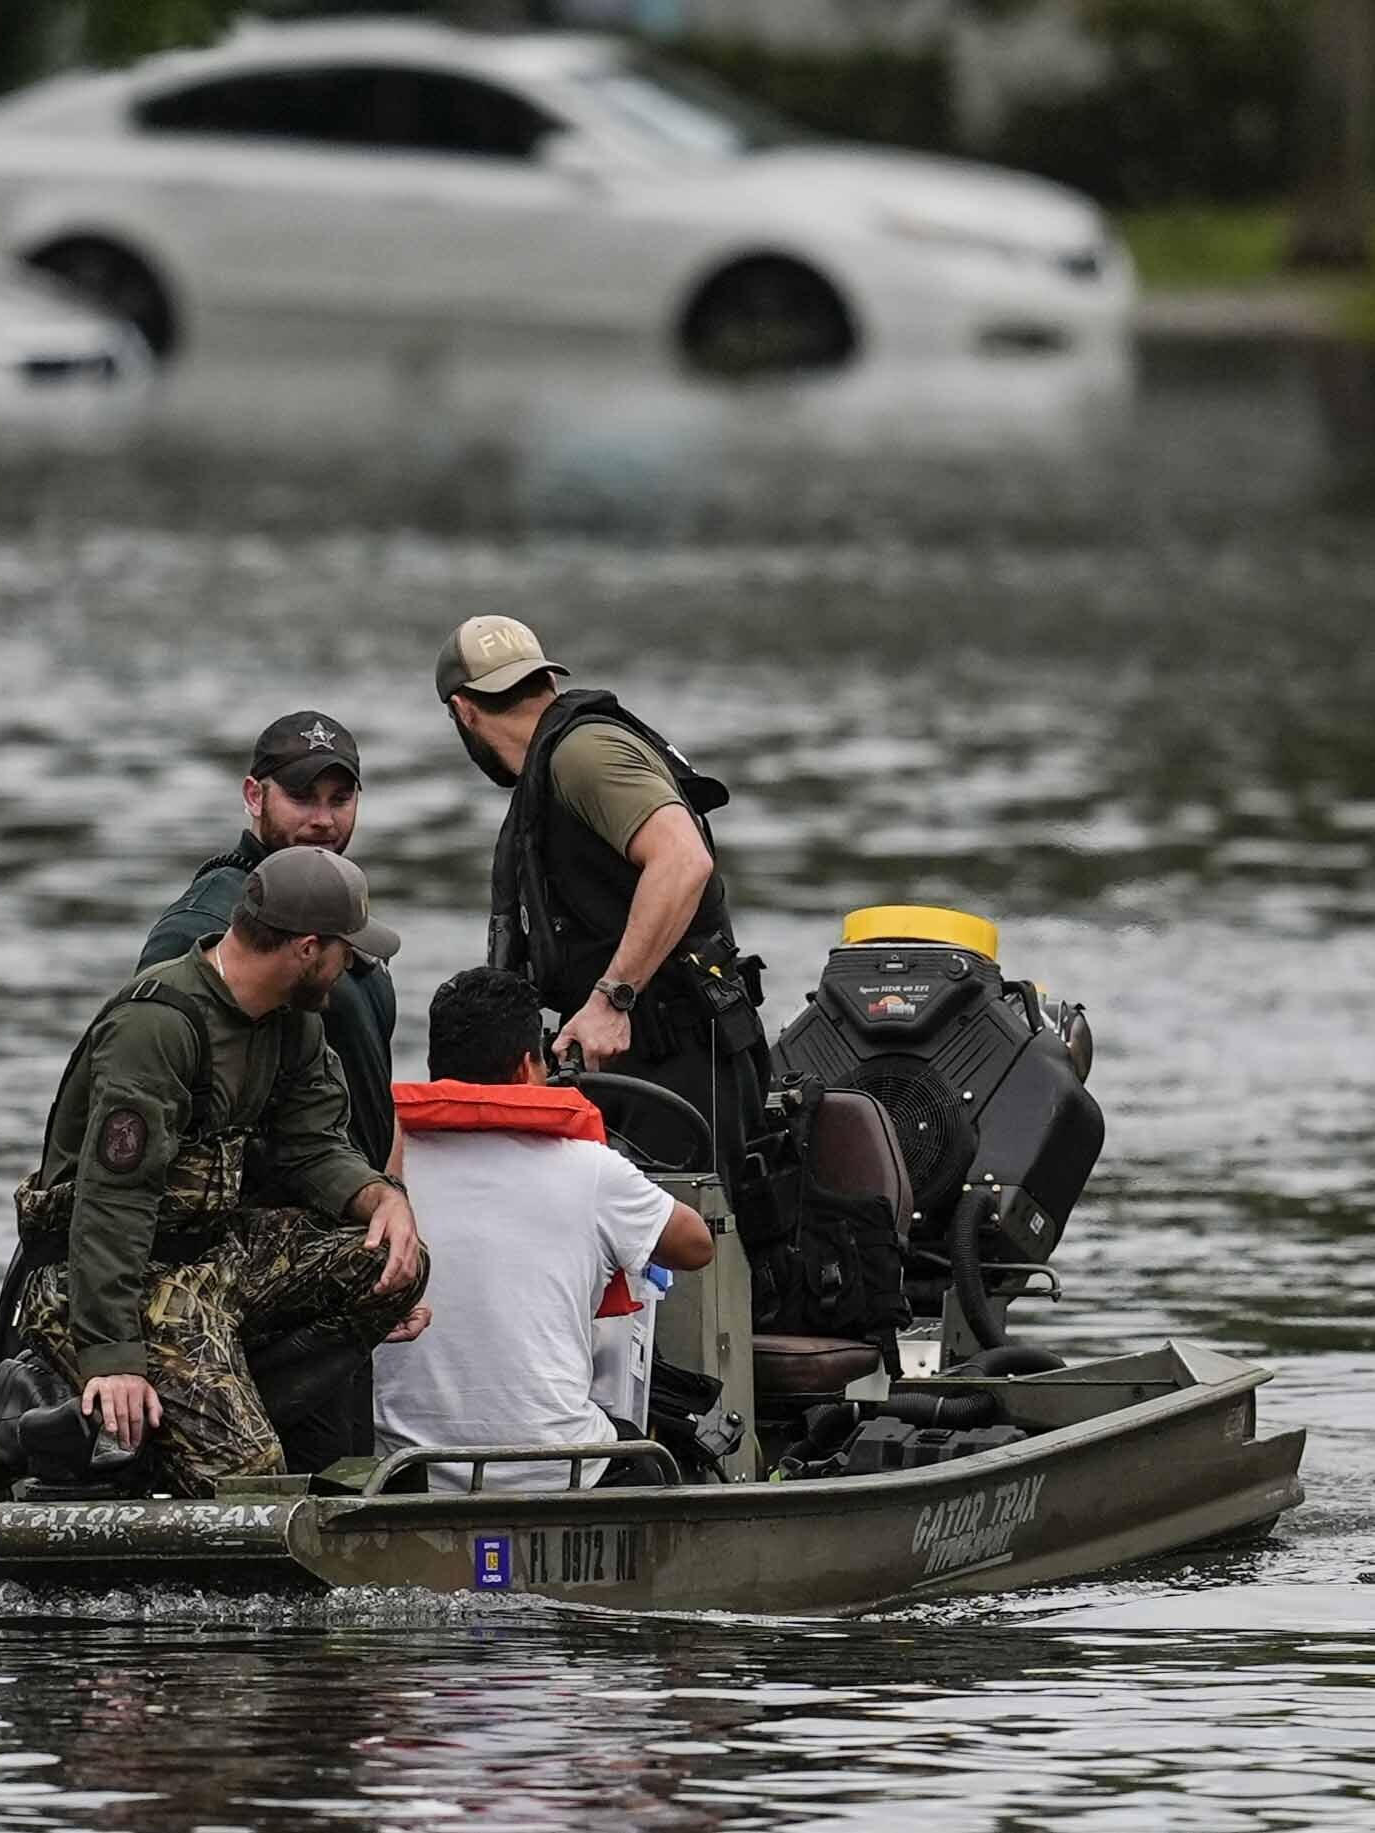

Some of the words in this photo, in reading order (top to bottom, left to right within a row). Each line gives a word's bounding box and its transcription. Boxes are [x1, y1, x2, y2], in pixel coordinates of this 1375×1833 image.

[912, 1490, 986, 1554] GATOR
[989, 1473, 1046, 1526] TRAX
[530, 1531, 548, 1584] FL
